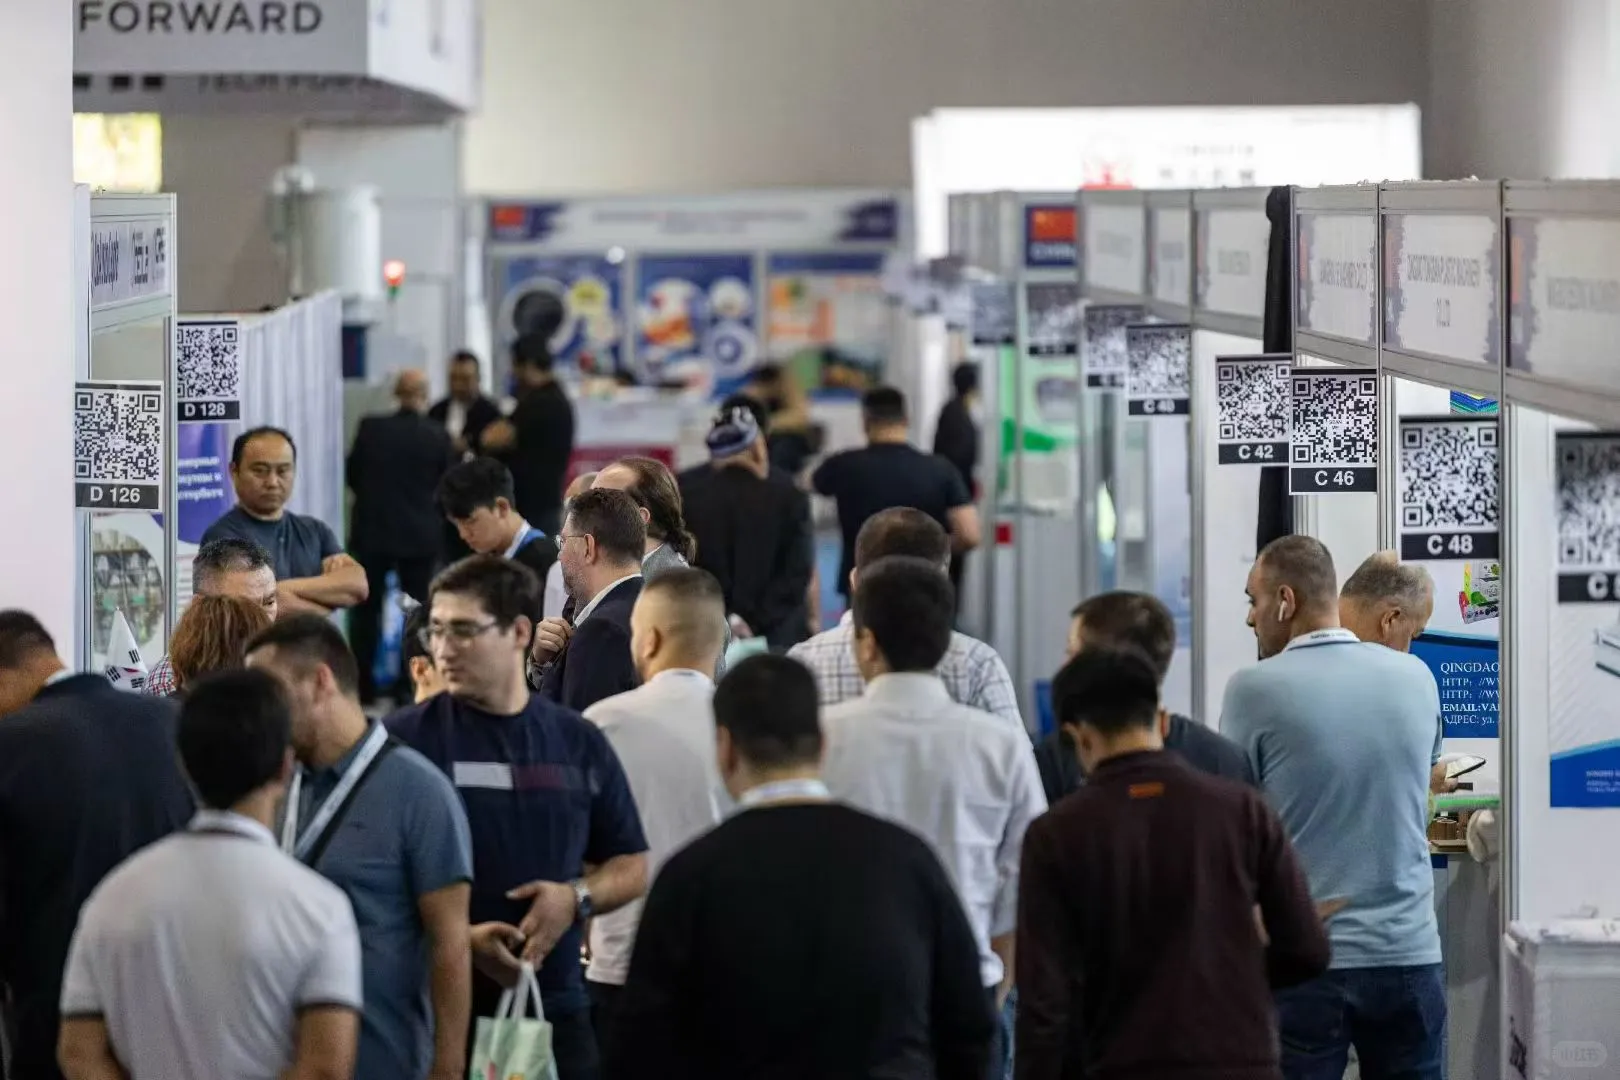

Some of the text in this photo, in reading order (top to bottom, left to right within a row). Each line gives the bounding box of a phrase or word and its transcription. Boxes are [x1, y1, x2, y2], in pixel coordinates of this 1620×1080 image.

[79, 1, 323, 34] FORWARD
[184, 402, 226, 417] D 128
[1143, 399, 1155, 414] C
[1238, 444, 1274, 460] C 42
[1315, 470, 1355, 486] C 46
[90, 486, 141, 503] D 126
[1427, 534, 1473, 555] C 48
[1587, 571, 1609, 600] C
